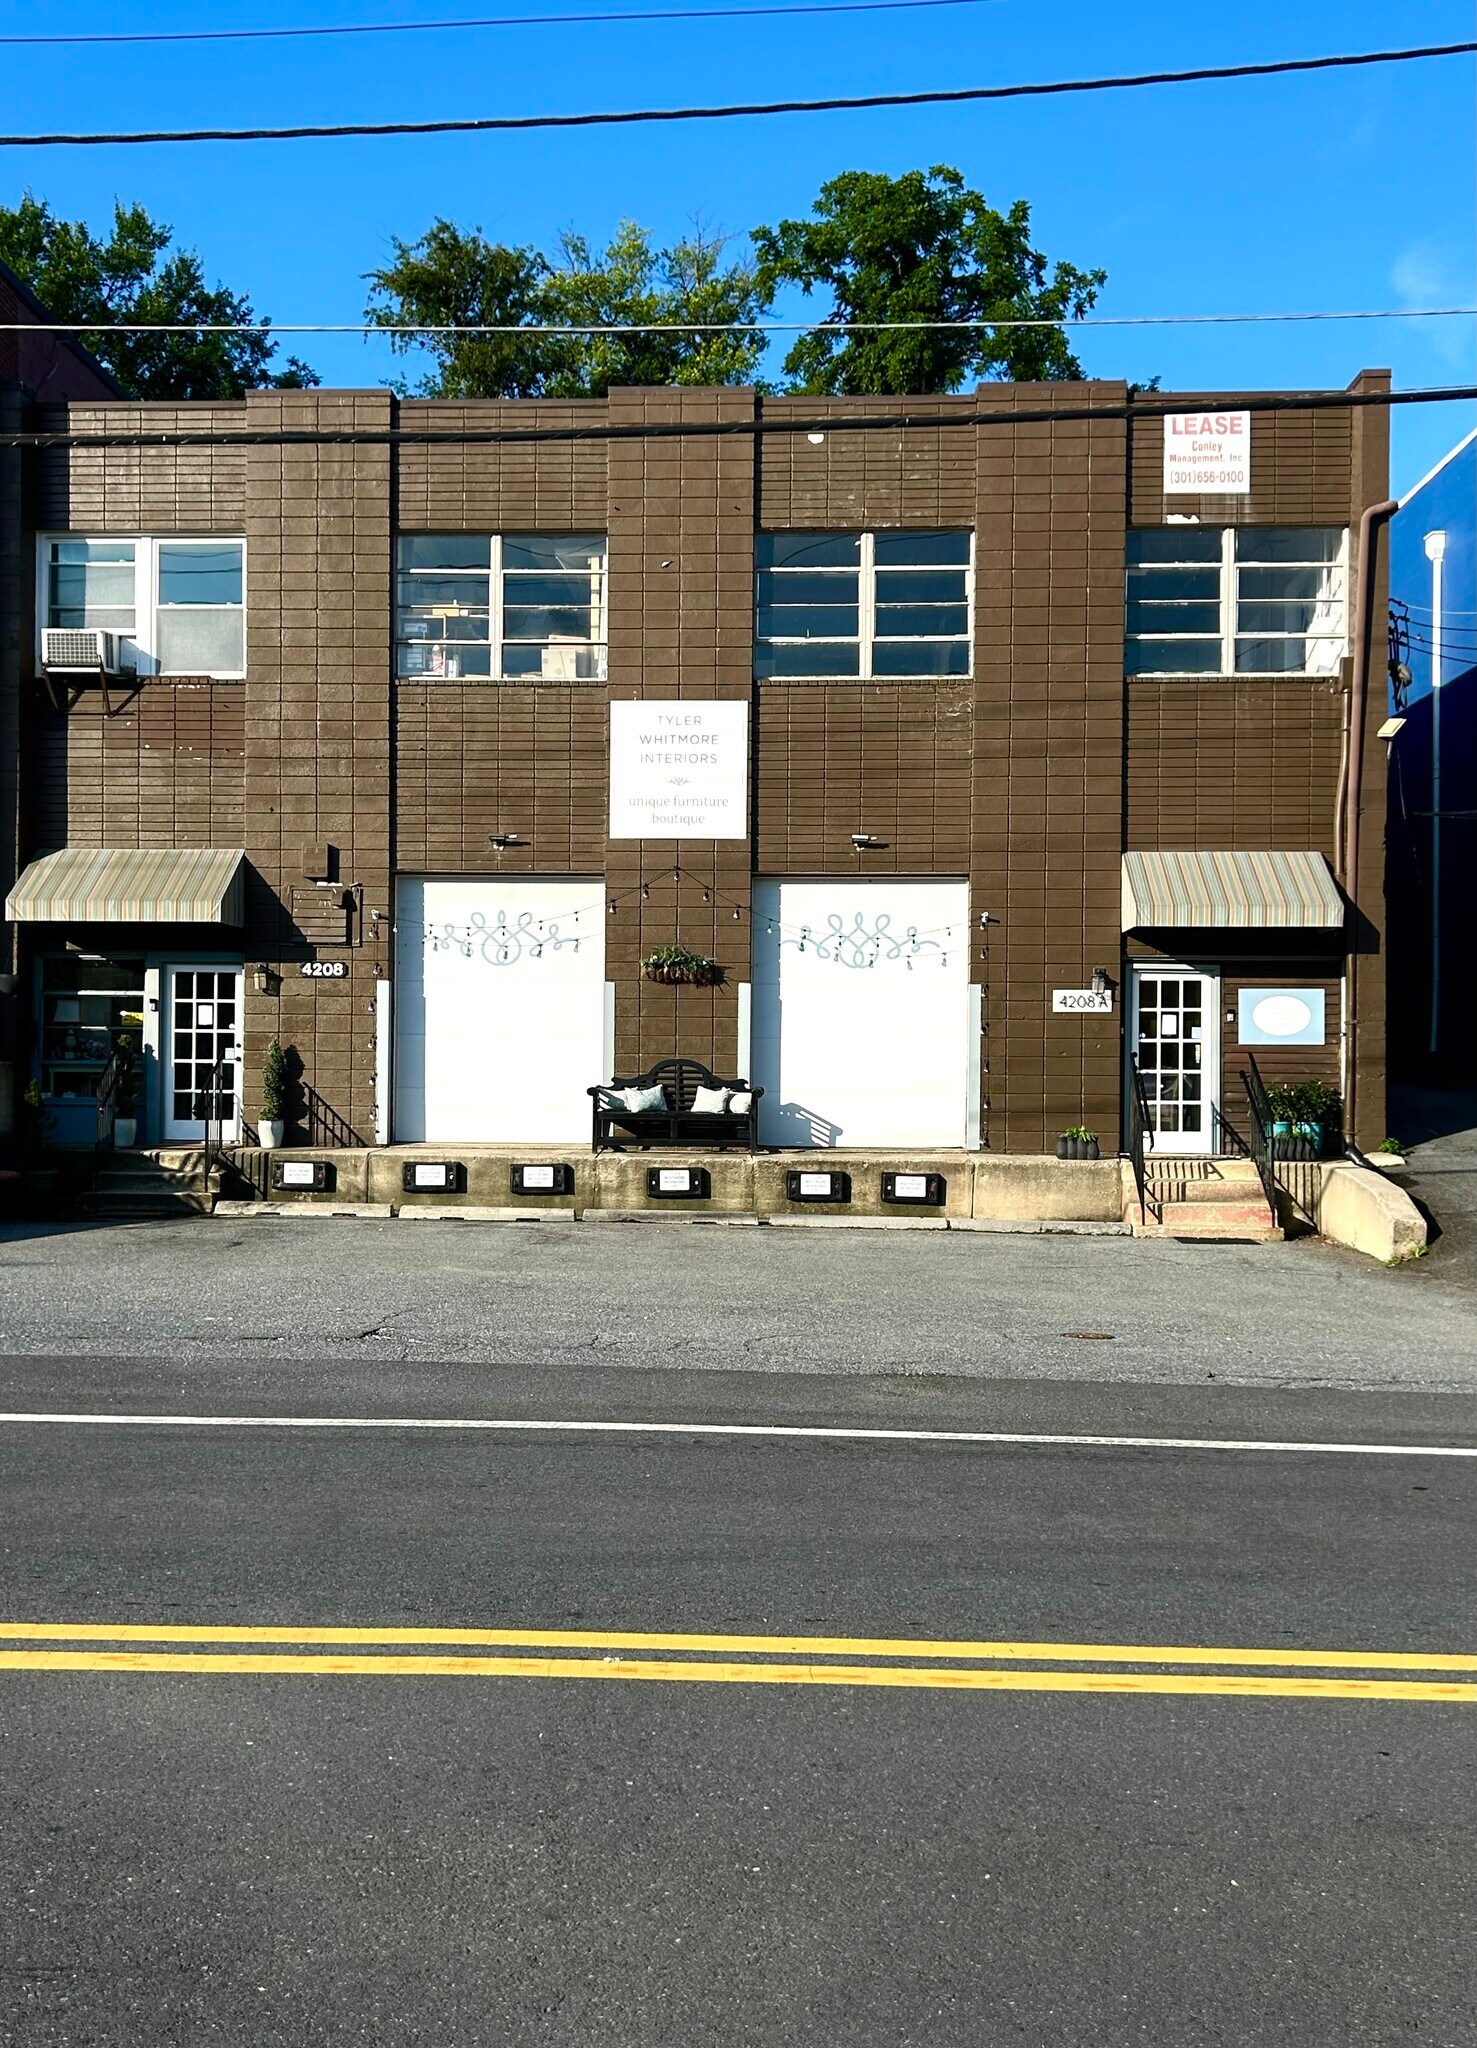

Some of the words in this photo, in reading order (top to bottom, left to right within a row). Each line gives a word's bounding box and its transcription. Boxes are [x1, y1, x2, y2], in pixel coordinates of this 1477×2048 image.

[1172, 416, 1243, 435] LEASE
[657, 715, 702, 726] TYLER
[639, 734, 719, 745] WHITMORE
[640, 753, 718, 764] INTERIORS
[628, 797, 670, 809] unique
[673, 795, 729, 807] furniture
[652, 813, 705, 826] boutique
[301, 962, 344, 976] 4208
